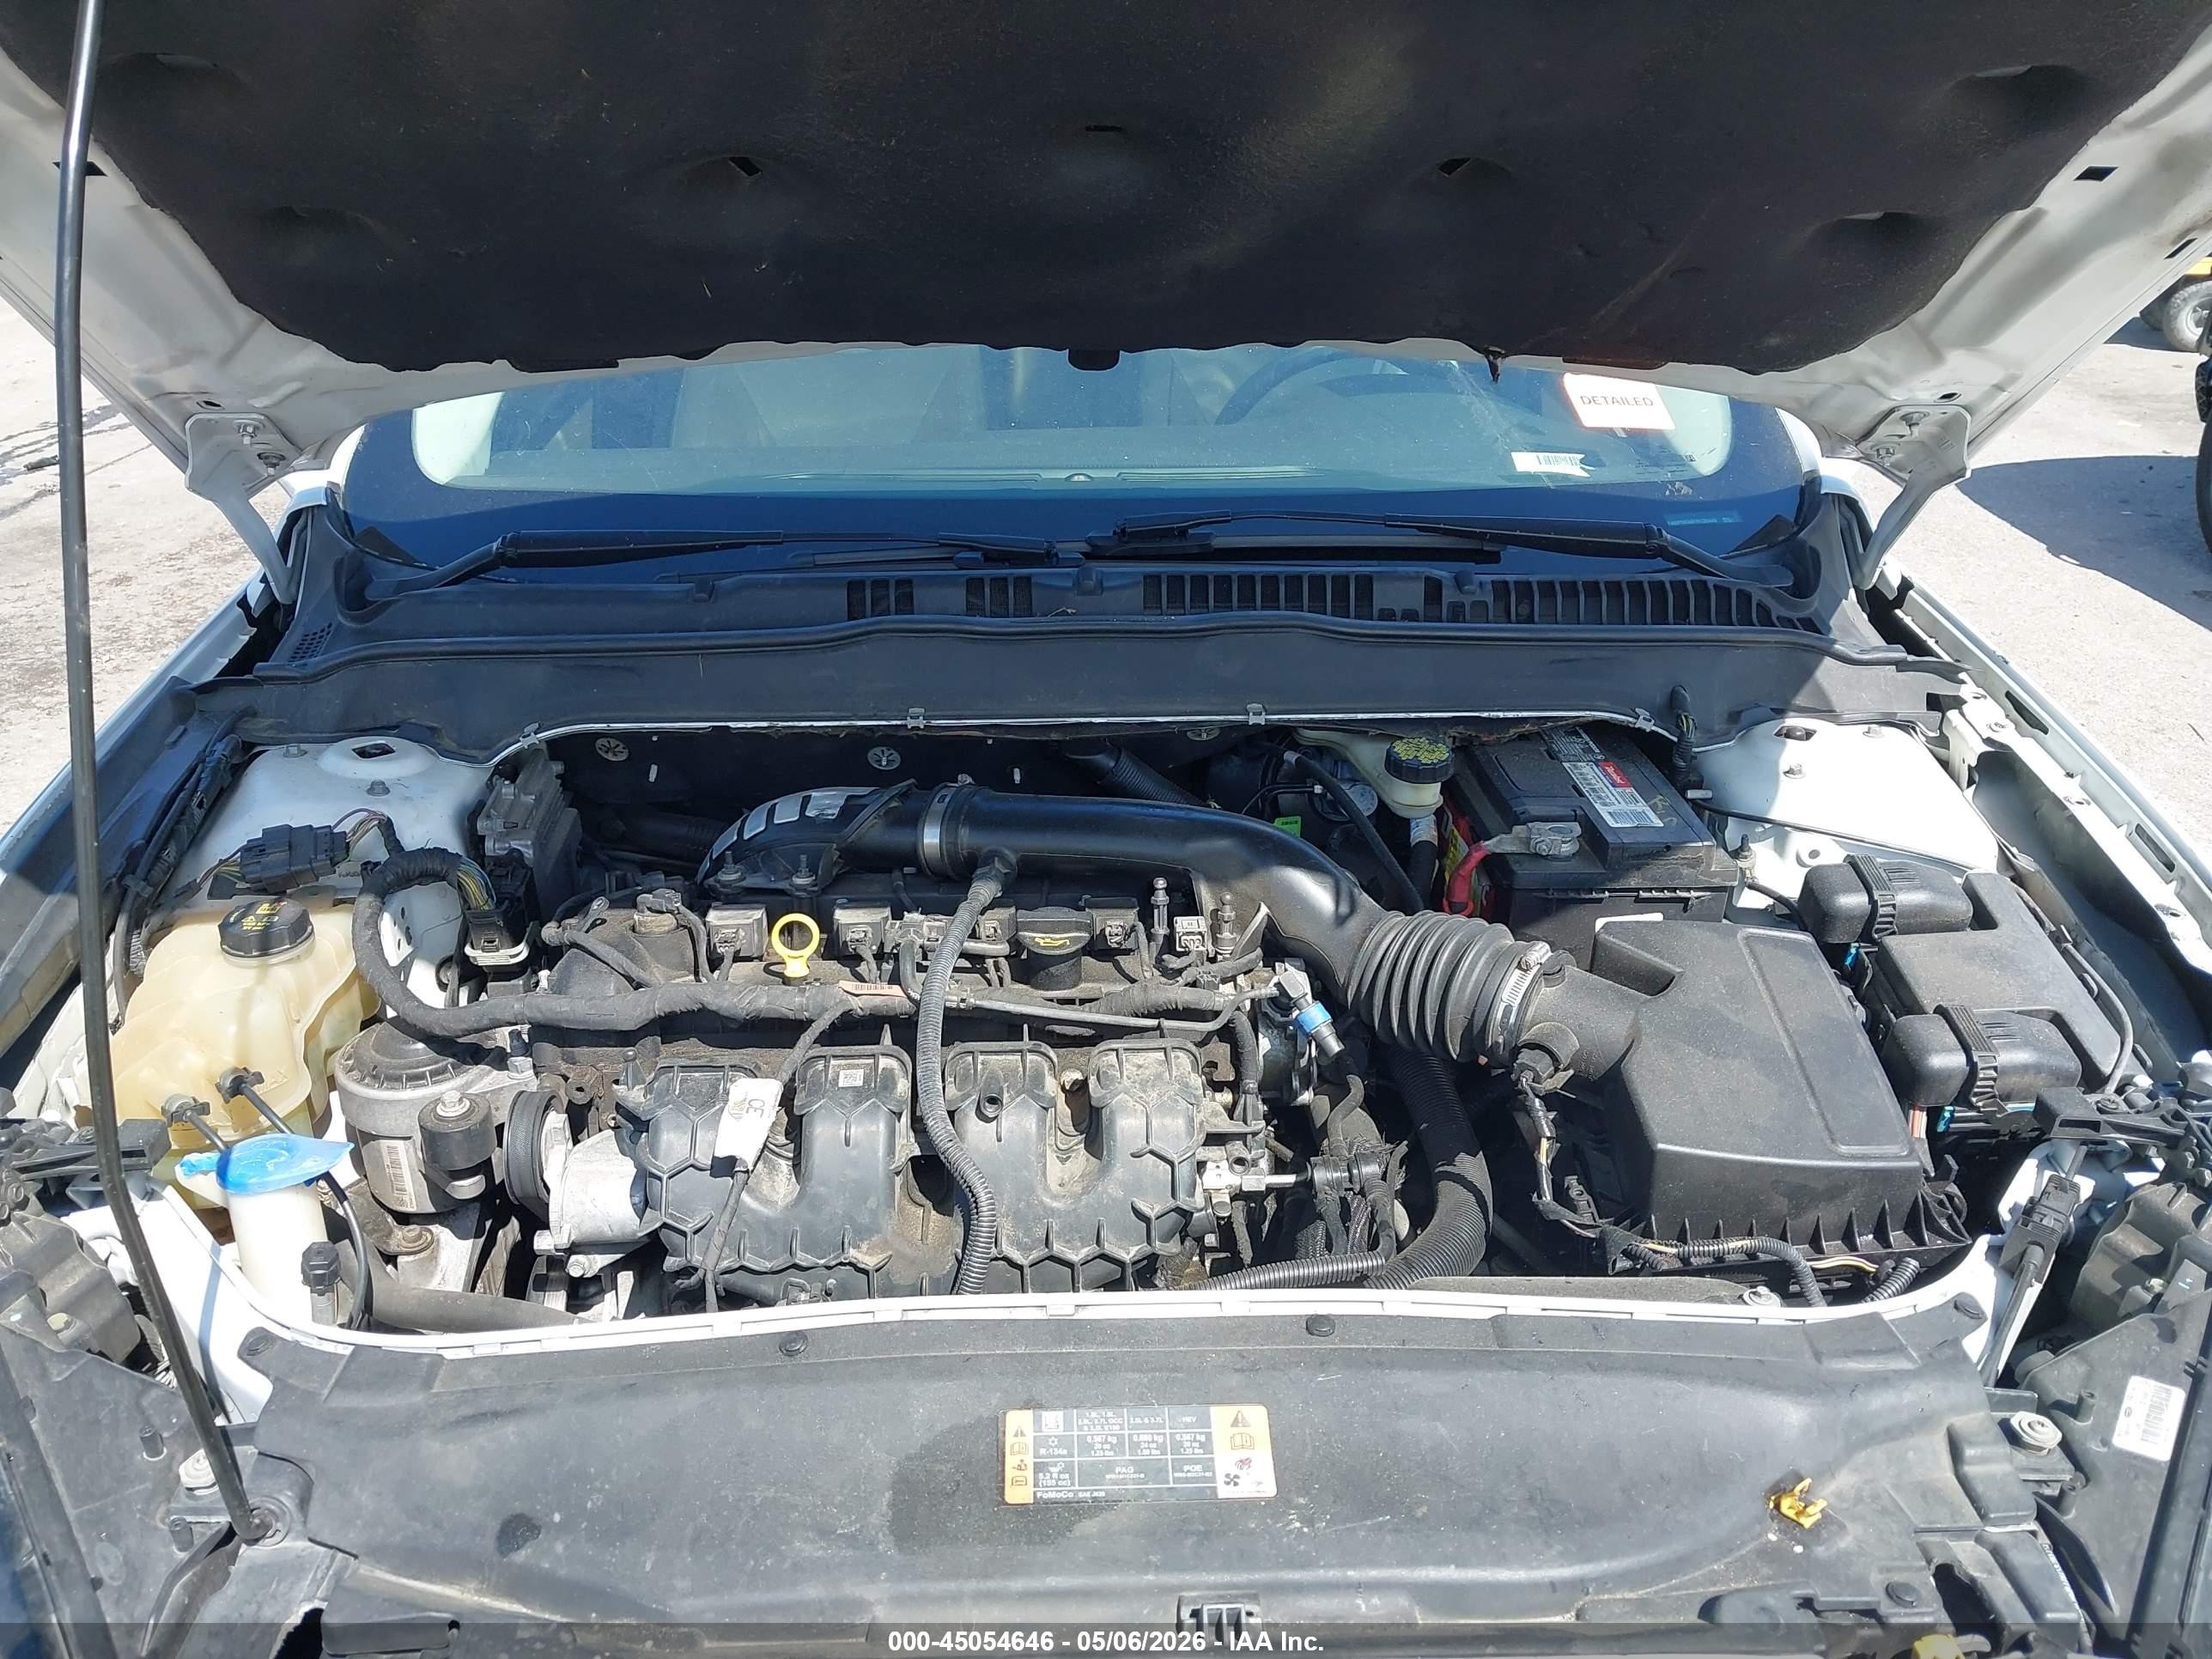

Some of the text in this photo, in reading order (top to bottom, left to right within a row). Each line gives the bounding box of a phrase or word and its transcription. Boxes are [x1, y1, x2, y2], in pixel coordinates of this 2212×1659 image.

[1580, 395, 1654, 407] DETAILED
[747, 1099, 766, 1118] CE
[1107, 1435, 1117, 1444] kg
[1153, 1434, 1164, 1443] kg
[1195, 1433, 1206, 1443] kg
[1039, 1479, 1056, 1487] (155
